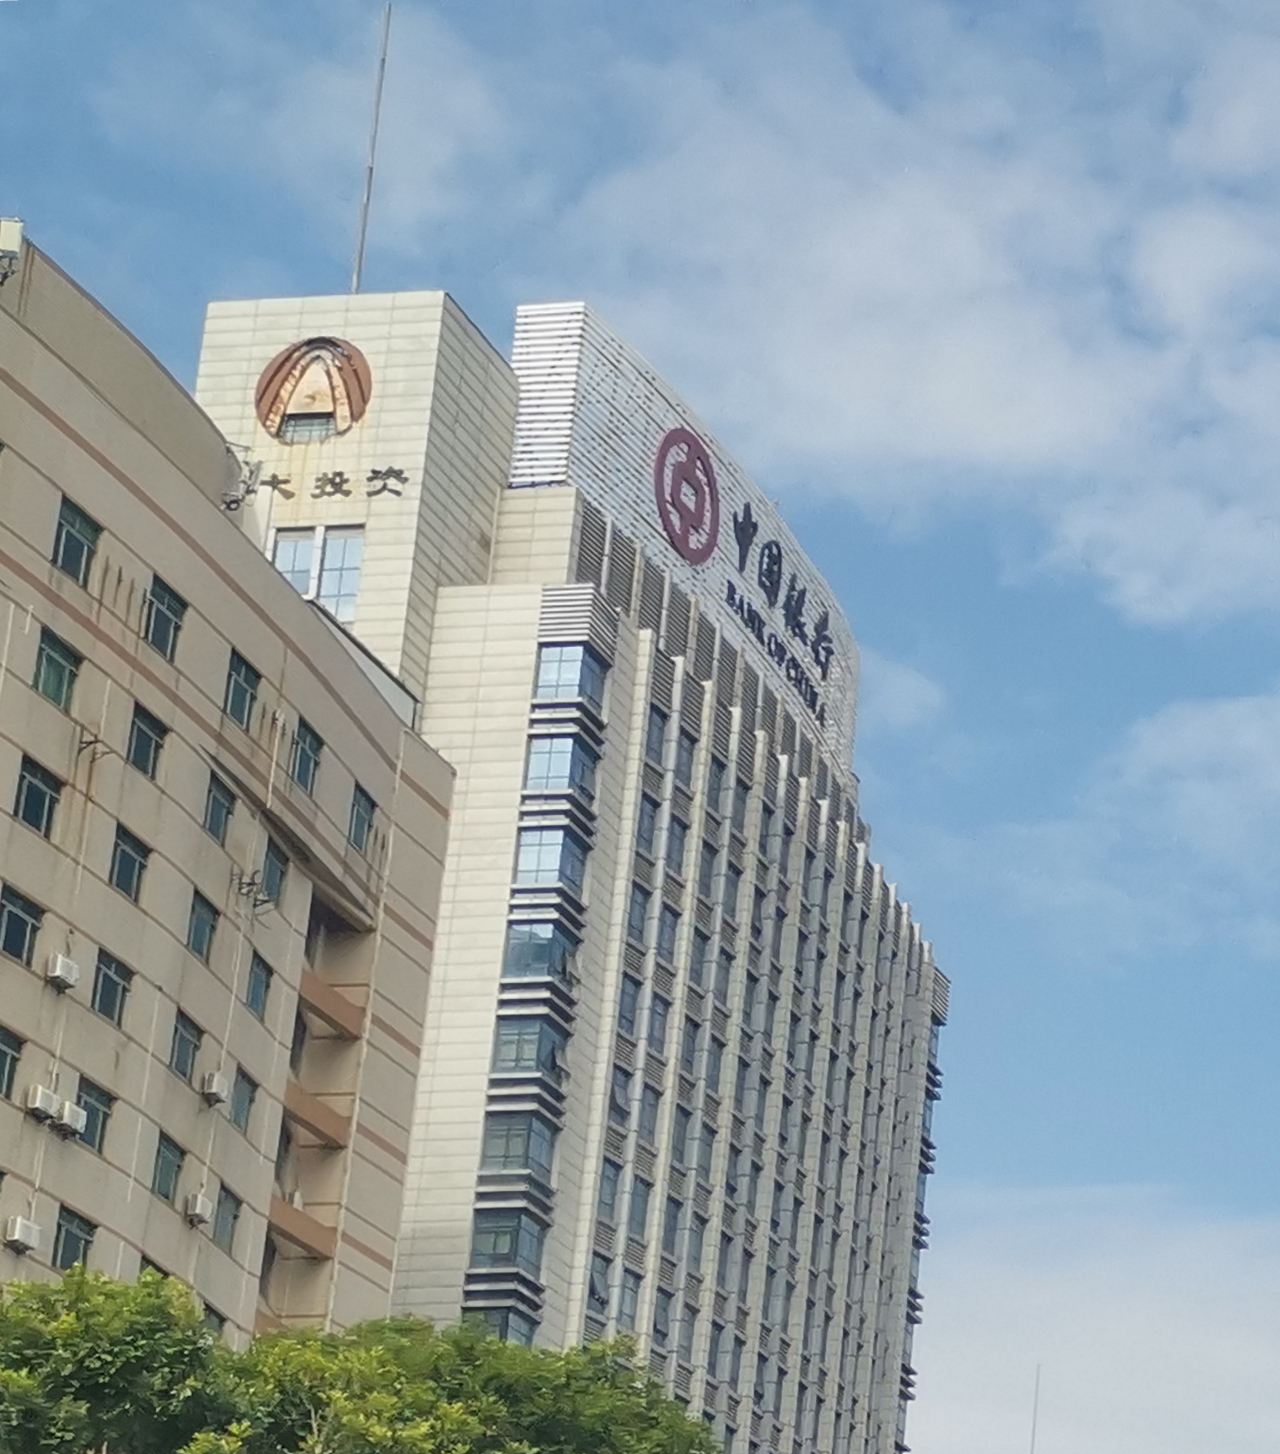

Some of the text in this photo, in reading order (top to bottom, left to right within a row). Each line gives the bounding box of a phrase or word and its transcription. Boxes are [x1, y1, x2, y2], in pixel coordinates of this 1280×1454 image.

[726, 579, 767, 647] BANK
[786, 656, 827, 728] CHINA
[732, 501, 835, 681] 中国银行
